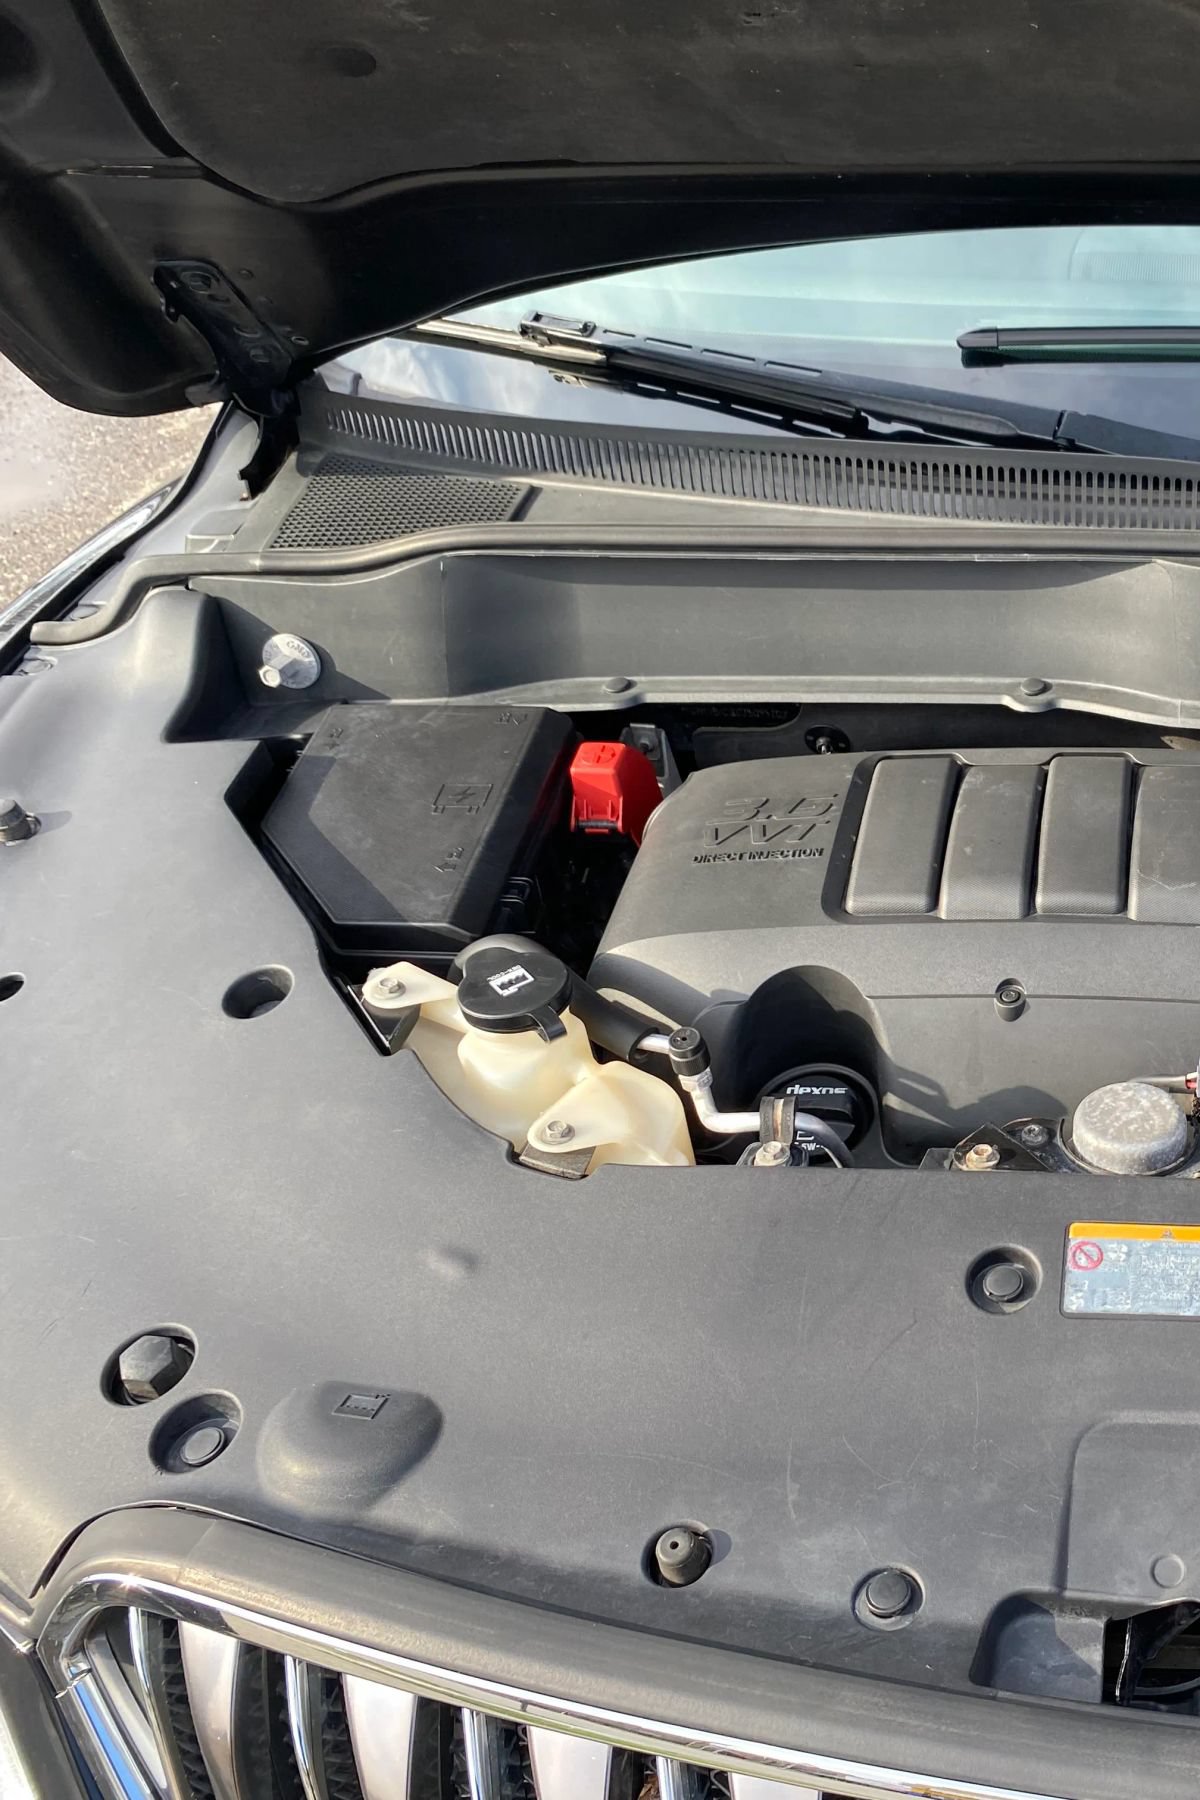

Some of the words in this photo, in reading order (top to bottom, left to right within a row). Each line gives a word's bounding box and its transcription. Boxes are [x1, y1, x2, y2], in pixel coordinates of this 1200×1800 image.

[704, 820, 832, 848] VVT
[692, 851, 747, 864] DIRECT
[748, 848, 825, 861] INJECTION
